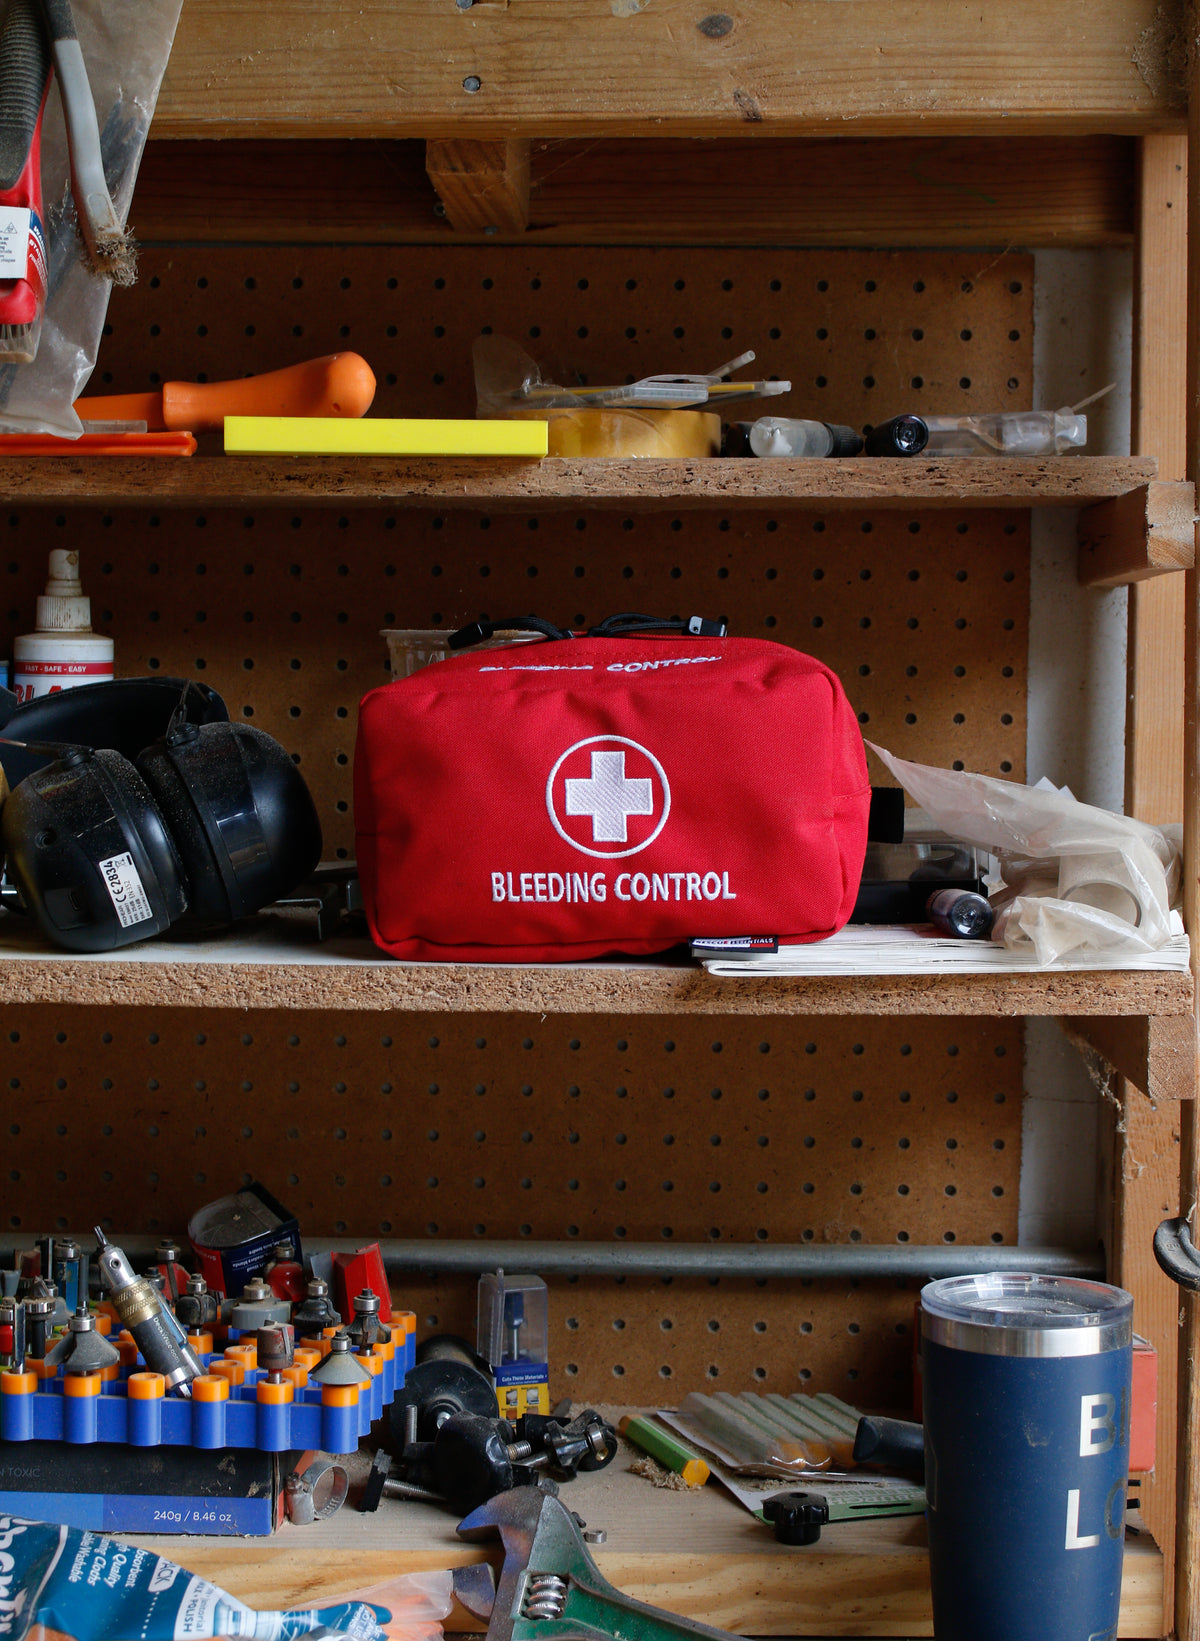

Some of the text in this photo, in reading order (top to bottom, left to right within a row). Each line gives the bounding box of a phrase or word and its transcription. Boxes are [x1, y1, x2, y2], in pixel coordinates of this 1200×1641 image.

[68, 665, 87, 673] EASY
[606, 655, 722, 673] CONTROL
[491, 871, 737, 903] BLEEDING CONTROL
[8, 1467, 41, 1478] TOXIC
[153, 1510, 182, 1522] 240g
[192, 1511, 216, 1521] 8.46
[218, 1513, 232, 1522] oz
[87, 1556, 107, 1587] Cloths
[103, 1553, 127, 1588] Quality
[183, 1598, 199, 1632] POLISH
